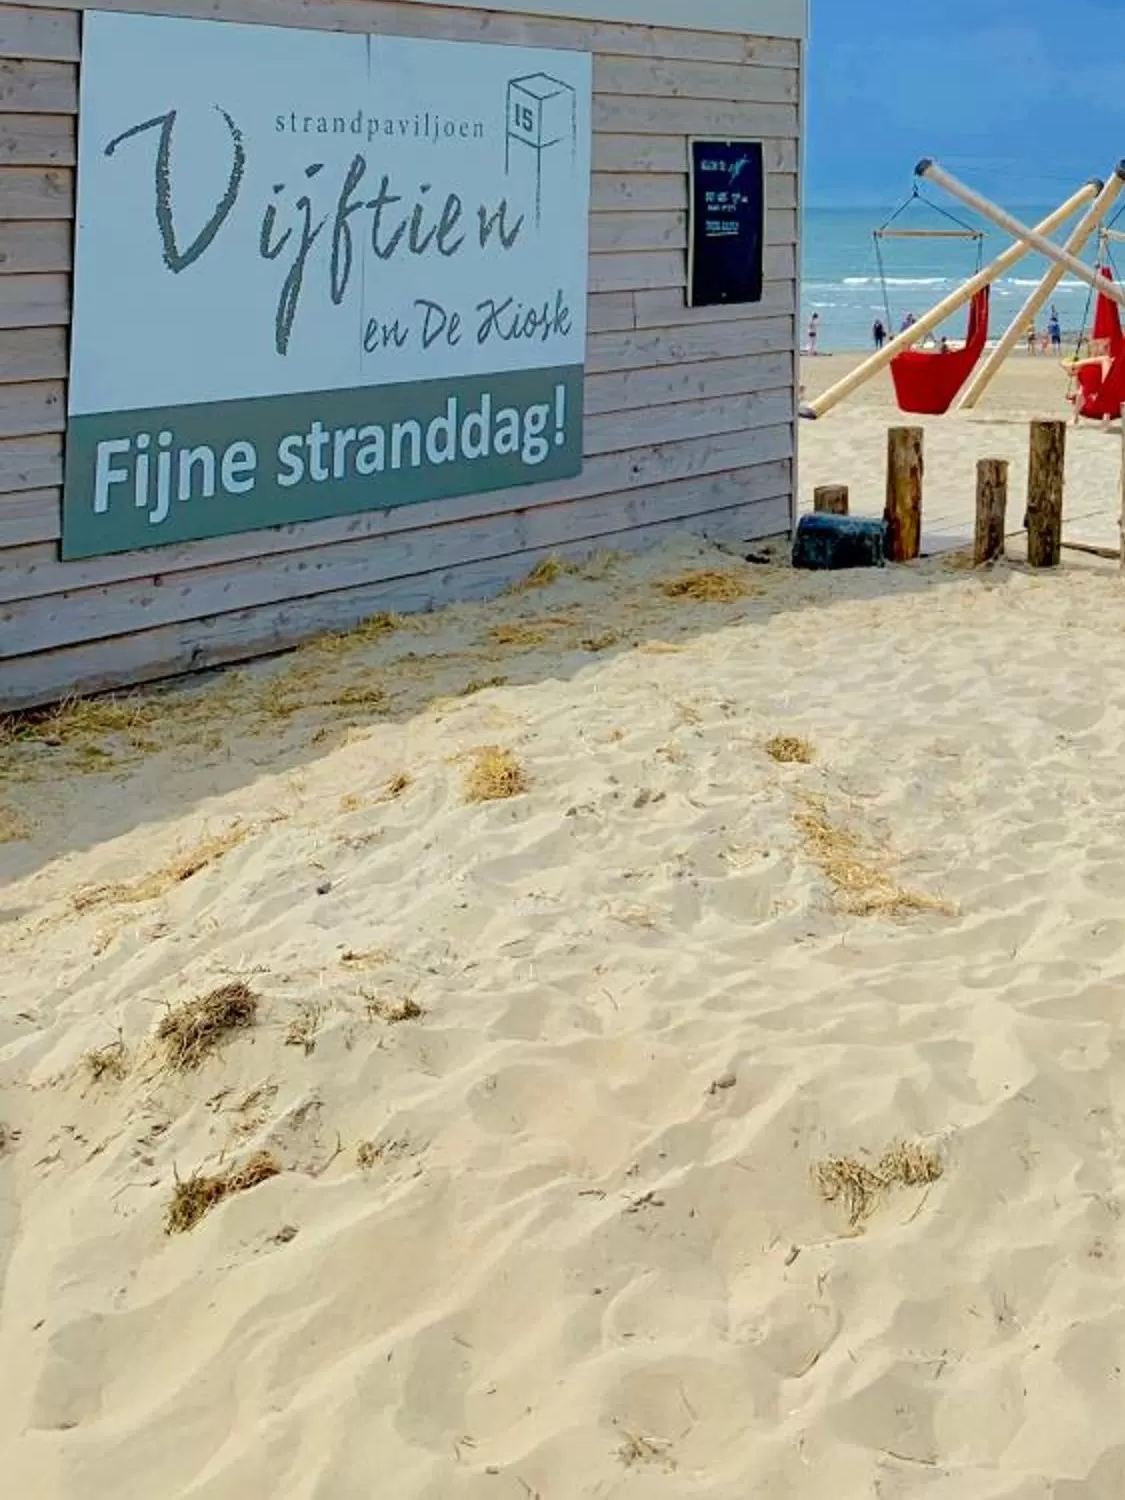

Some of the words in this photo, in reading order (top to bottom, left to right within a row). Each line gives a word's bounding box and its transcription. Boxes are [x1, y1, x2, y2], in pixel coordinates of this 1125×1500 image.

[275, 110, 485, 142] strandpaviljoen
[105, 104, 524, 356] Vijftien
[363, 318, 409, 353] en
[415, 299, 462, 348] De
[476, 289, 572, 346] Kiosk
[93, 430, 258, 525] Fijne
[277, 383, 565, 487] stranddag!
